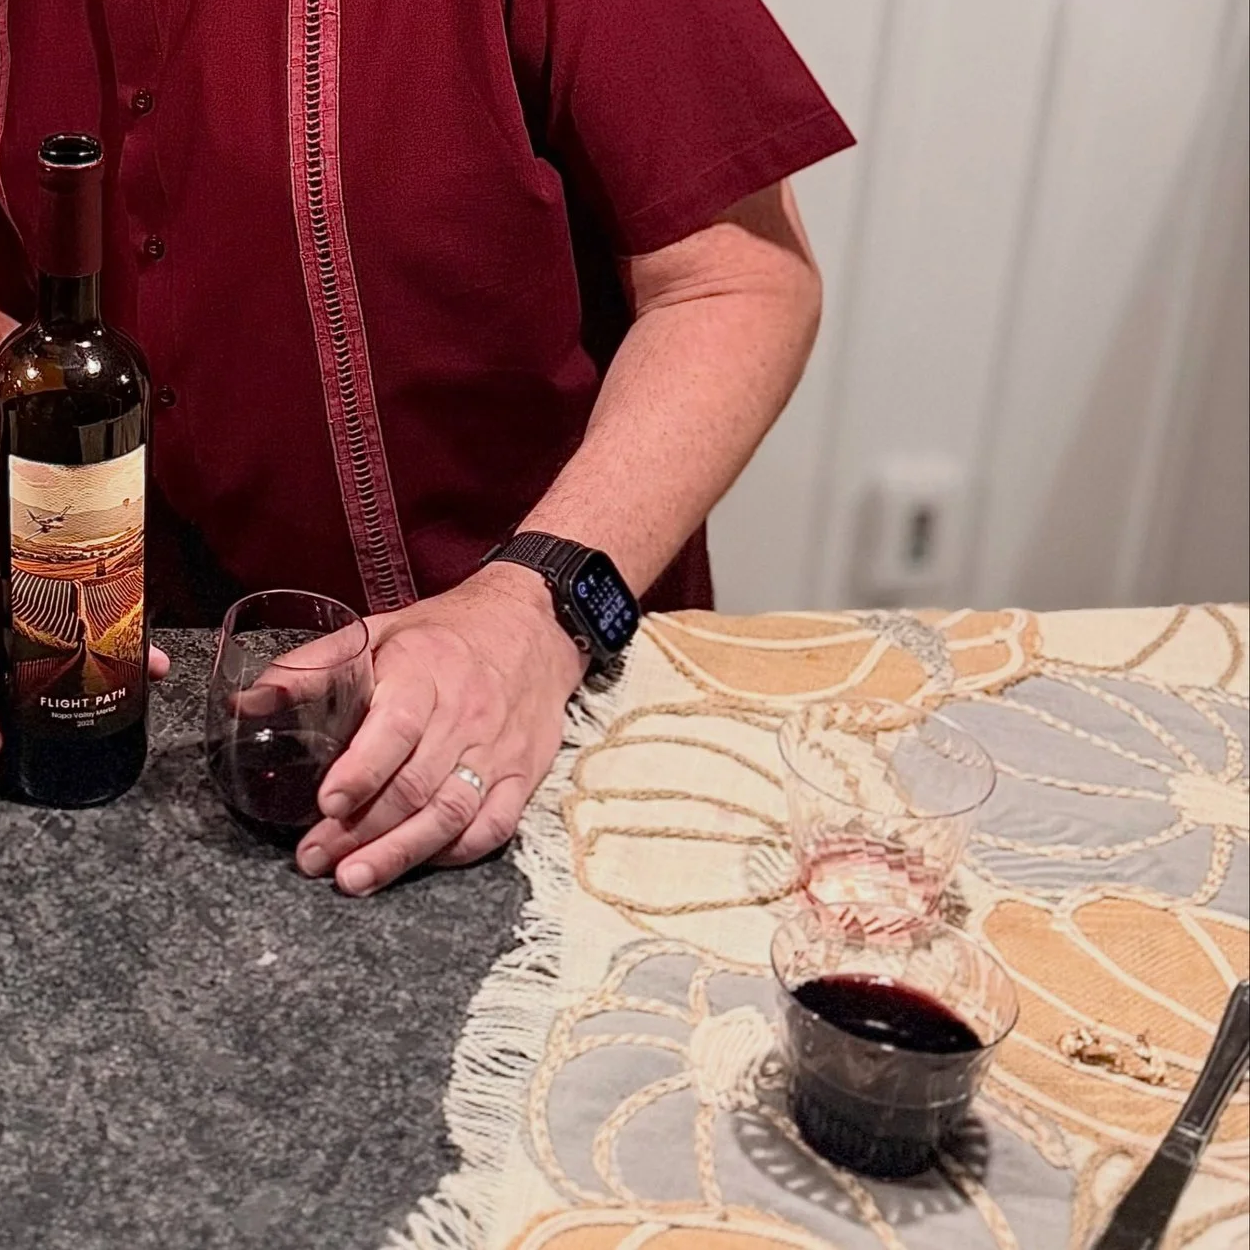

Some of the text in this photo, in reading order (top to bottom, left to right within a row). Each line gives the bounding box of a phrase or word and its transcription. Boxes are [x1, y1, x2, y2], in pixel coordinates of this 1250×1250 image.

[40, 687, 126, 709] FLIGHT PATH
[51, 711, 72, 720] Napa
[96, 705, 117, 716] Merlot
